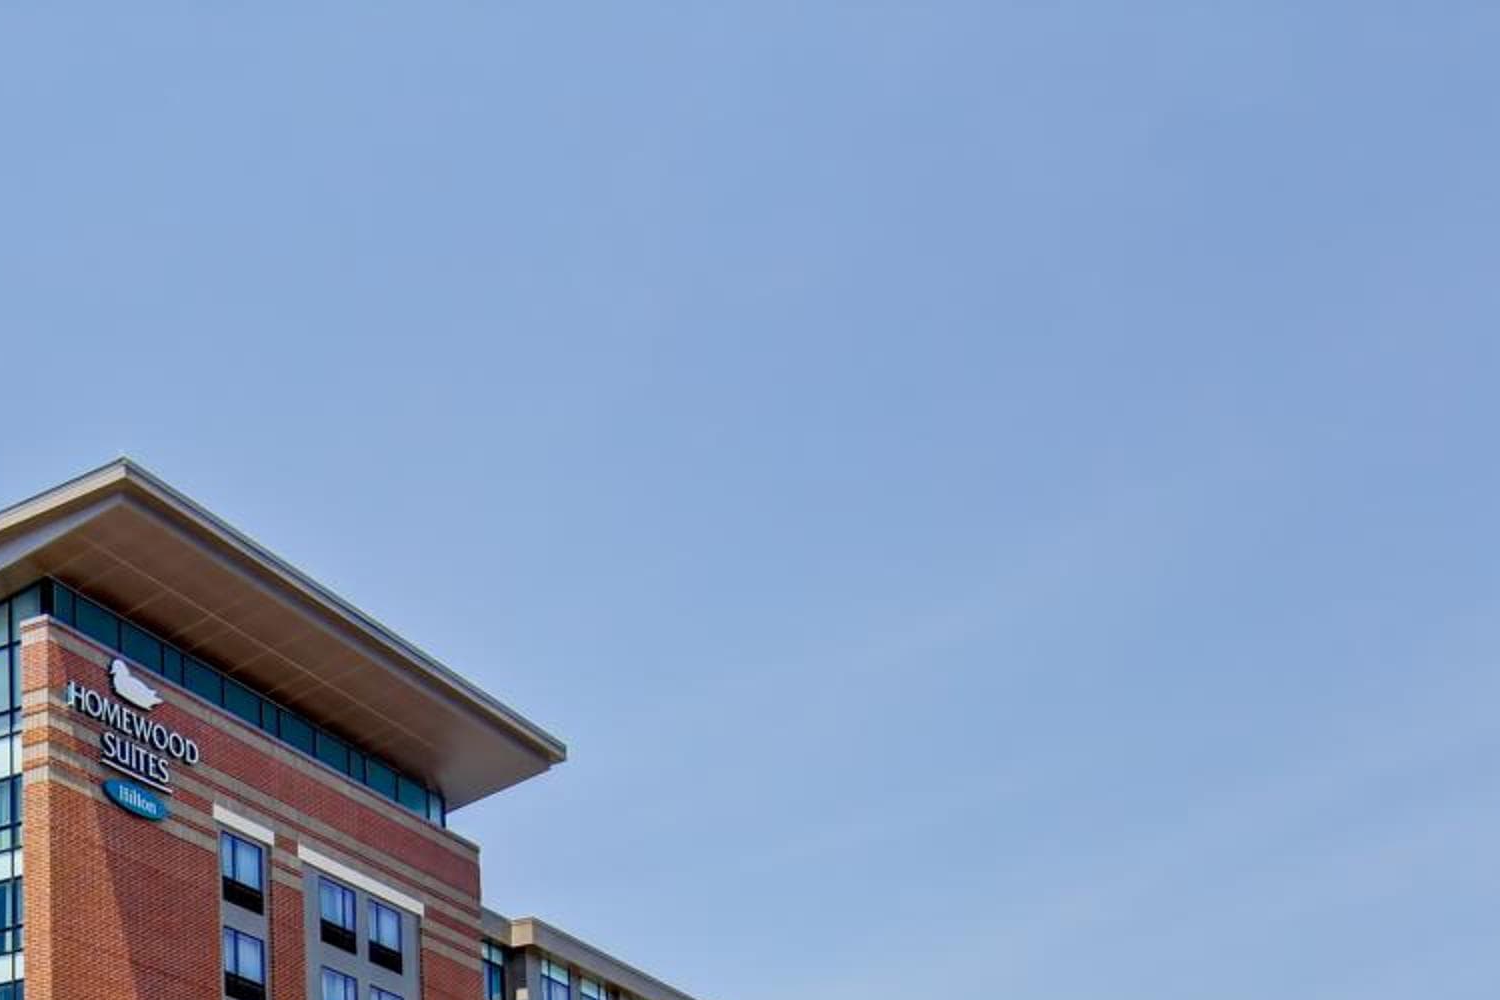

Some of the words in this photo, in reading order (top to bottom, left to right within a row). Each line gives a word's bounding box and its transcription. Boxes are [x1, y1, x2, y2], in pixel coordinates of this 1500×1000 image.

[68, 681, 199, 764] HOMEWOOD
[103, 732, 169, 783] SUITES
[119, 785, 157, 815] Hilton
